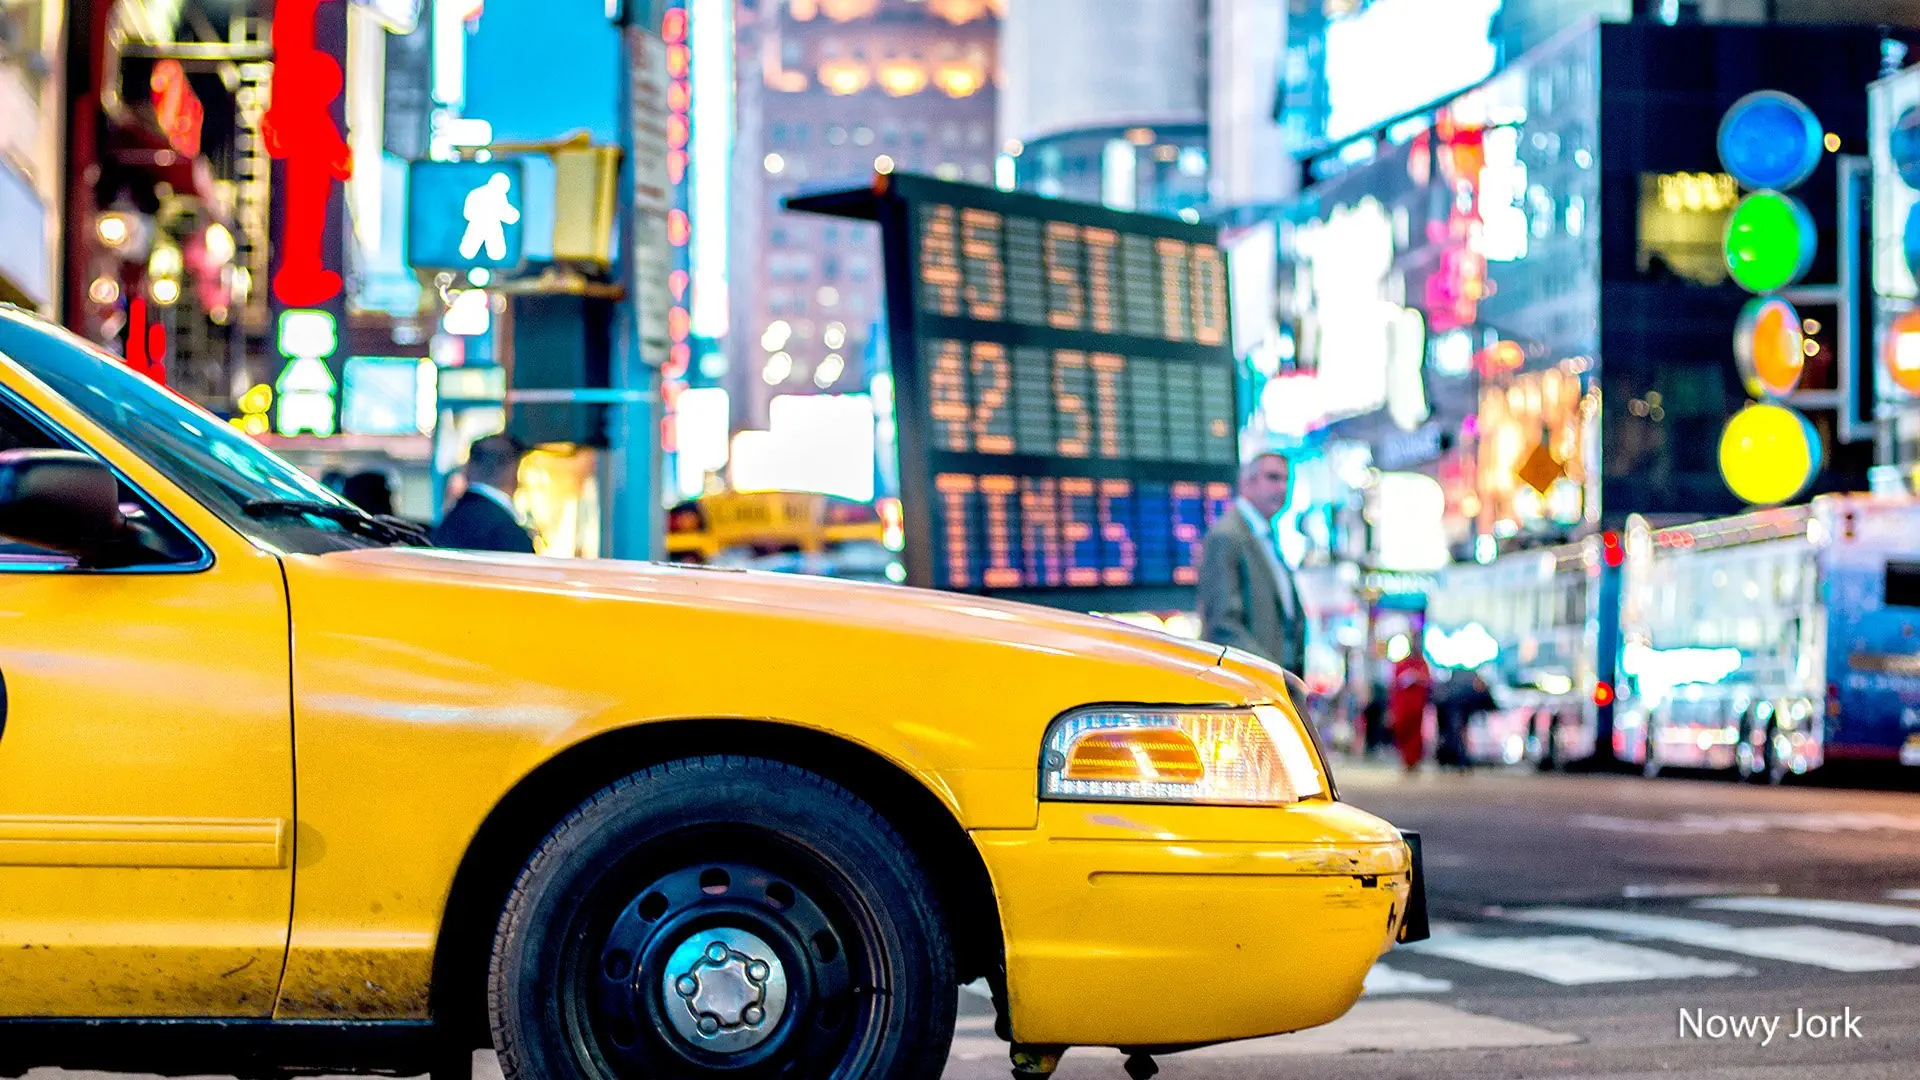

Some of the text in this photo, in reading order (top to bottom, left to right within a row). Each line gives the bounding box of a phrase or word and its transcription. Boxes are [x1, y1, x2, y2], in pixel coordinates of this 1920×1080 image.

[920, 204, 1228, 346] 45 ST TO
[929, 338, 1127, 458] 42 ST
[934, 473, 1137, 588] TIMES
